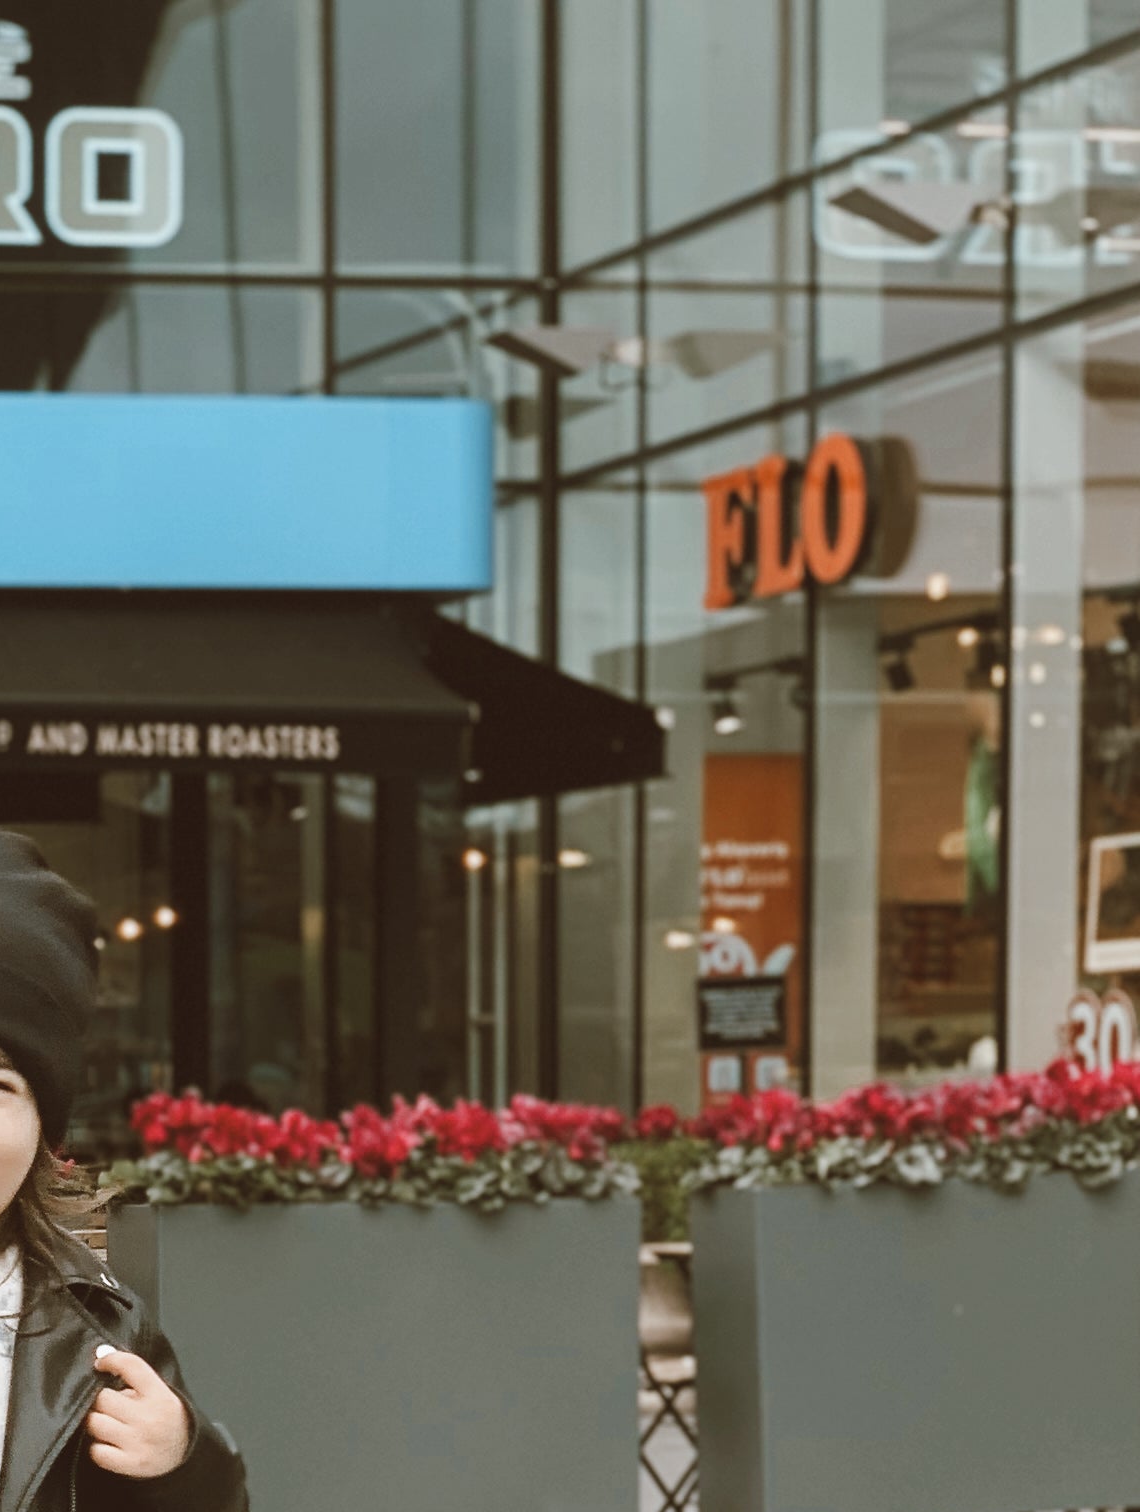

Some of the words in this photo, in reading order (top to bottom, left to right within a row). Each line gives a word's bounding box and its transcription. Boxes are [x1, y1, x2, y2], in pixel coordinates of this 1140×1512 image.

[702, 433, 867, 610] FLO
[26, 721, 89, 756] AND
[95, 722, 199, 758] MASTER
[207, 722, 341, 760] ROASTERS
